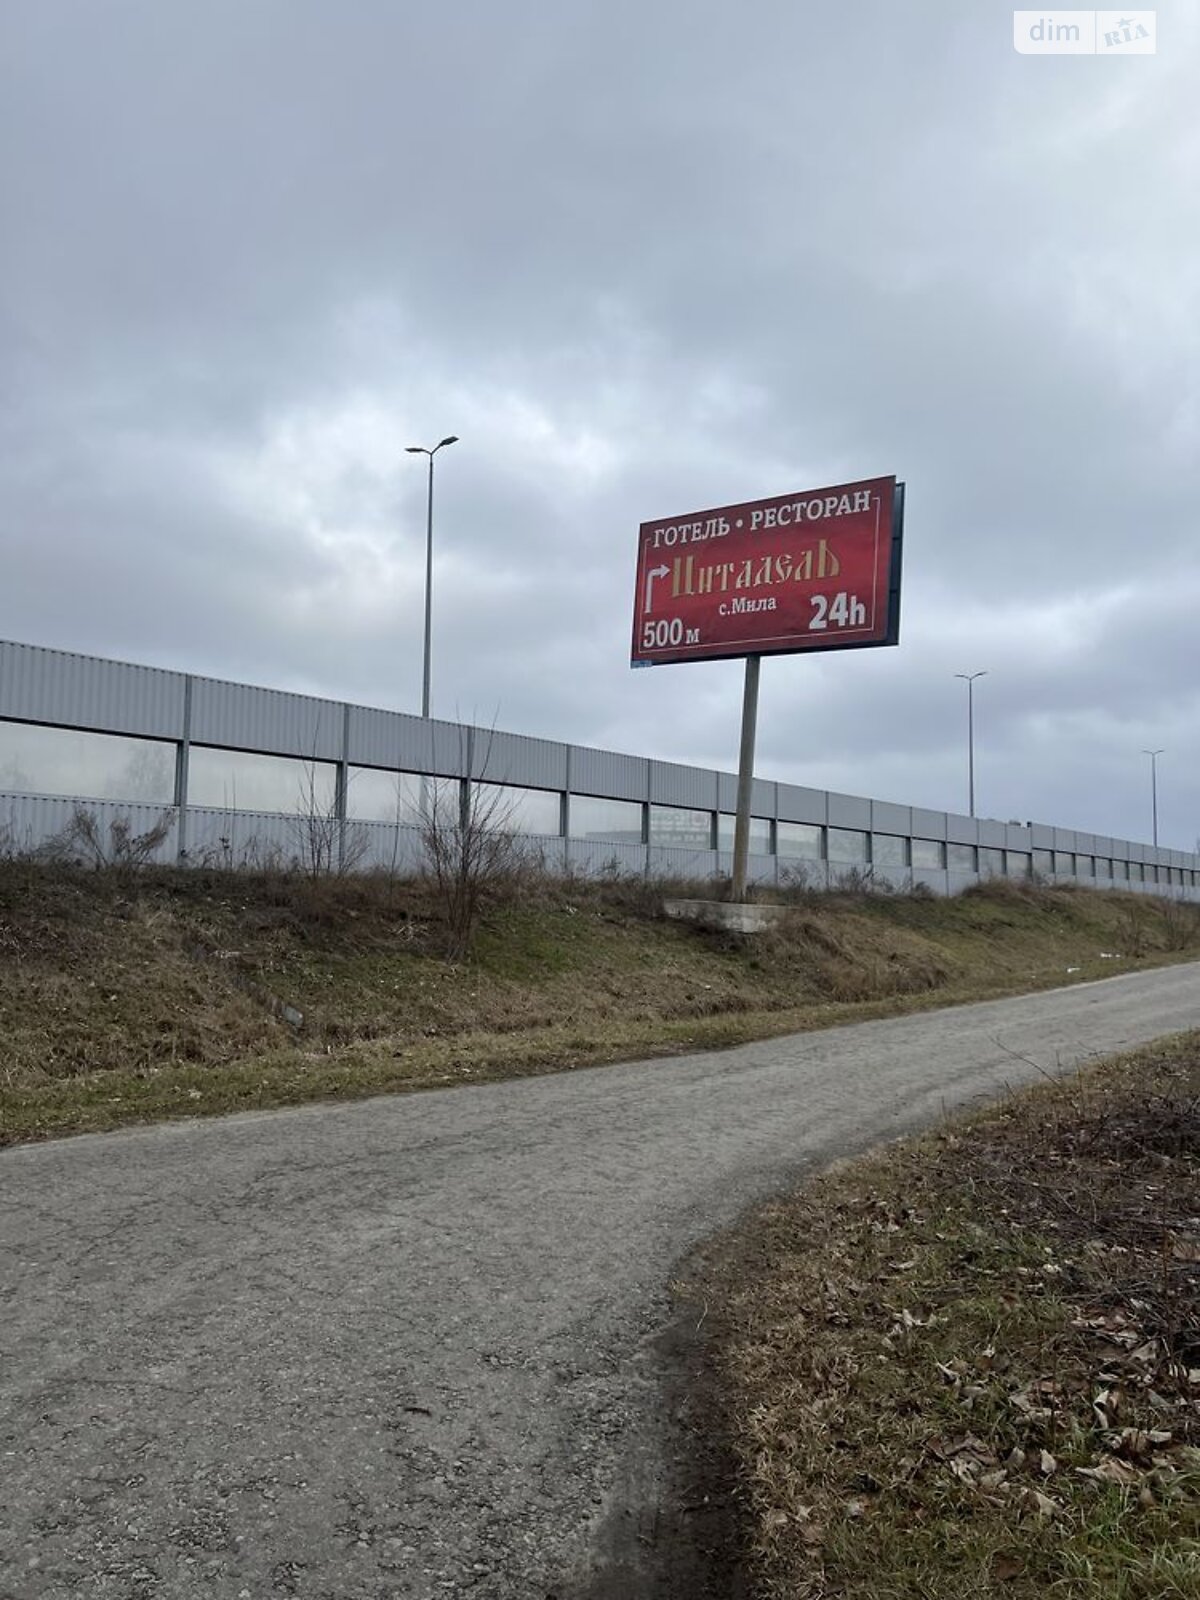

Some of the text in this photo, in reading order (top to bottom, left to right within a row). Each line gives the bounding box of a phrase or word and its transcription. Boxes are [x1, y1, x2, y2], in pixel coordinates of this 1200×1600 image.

[653, 490, 871, 548] ГОТЕЛЬ РЕСТОРАН
[719, 597, 777, 616] с.Мила
[809, 592, 865, 630] 24h
[643, 618, 684, 648] 500
